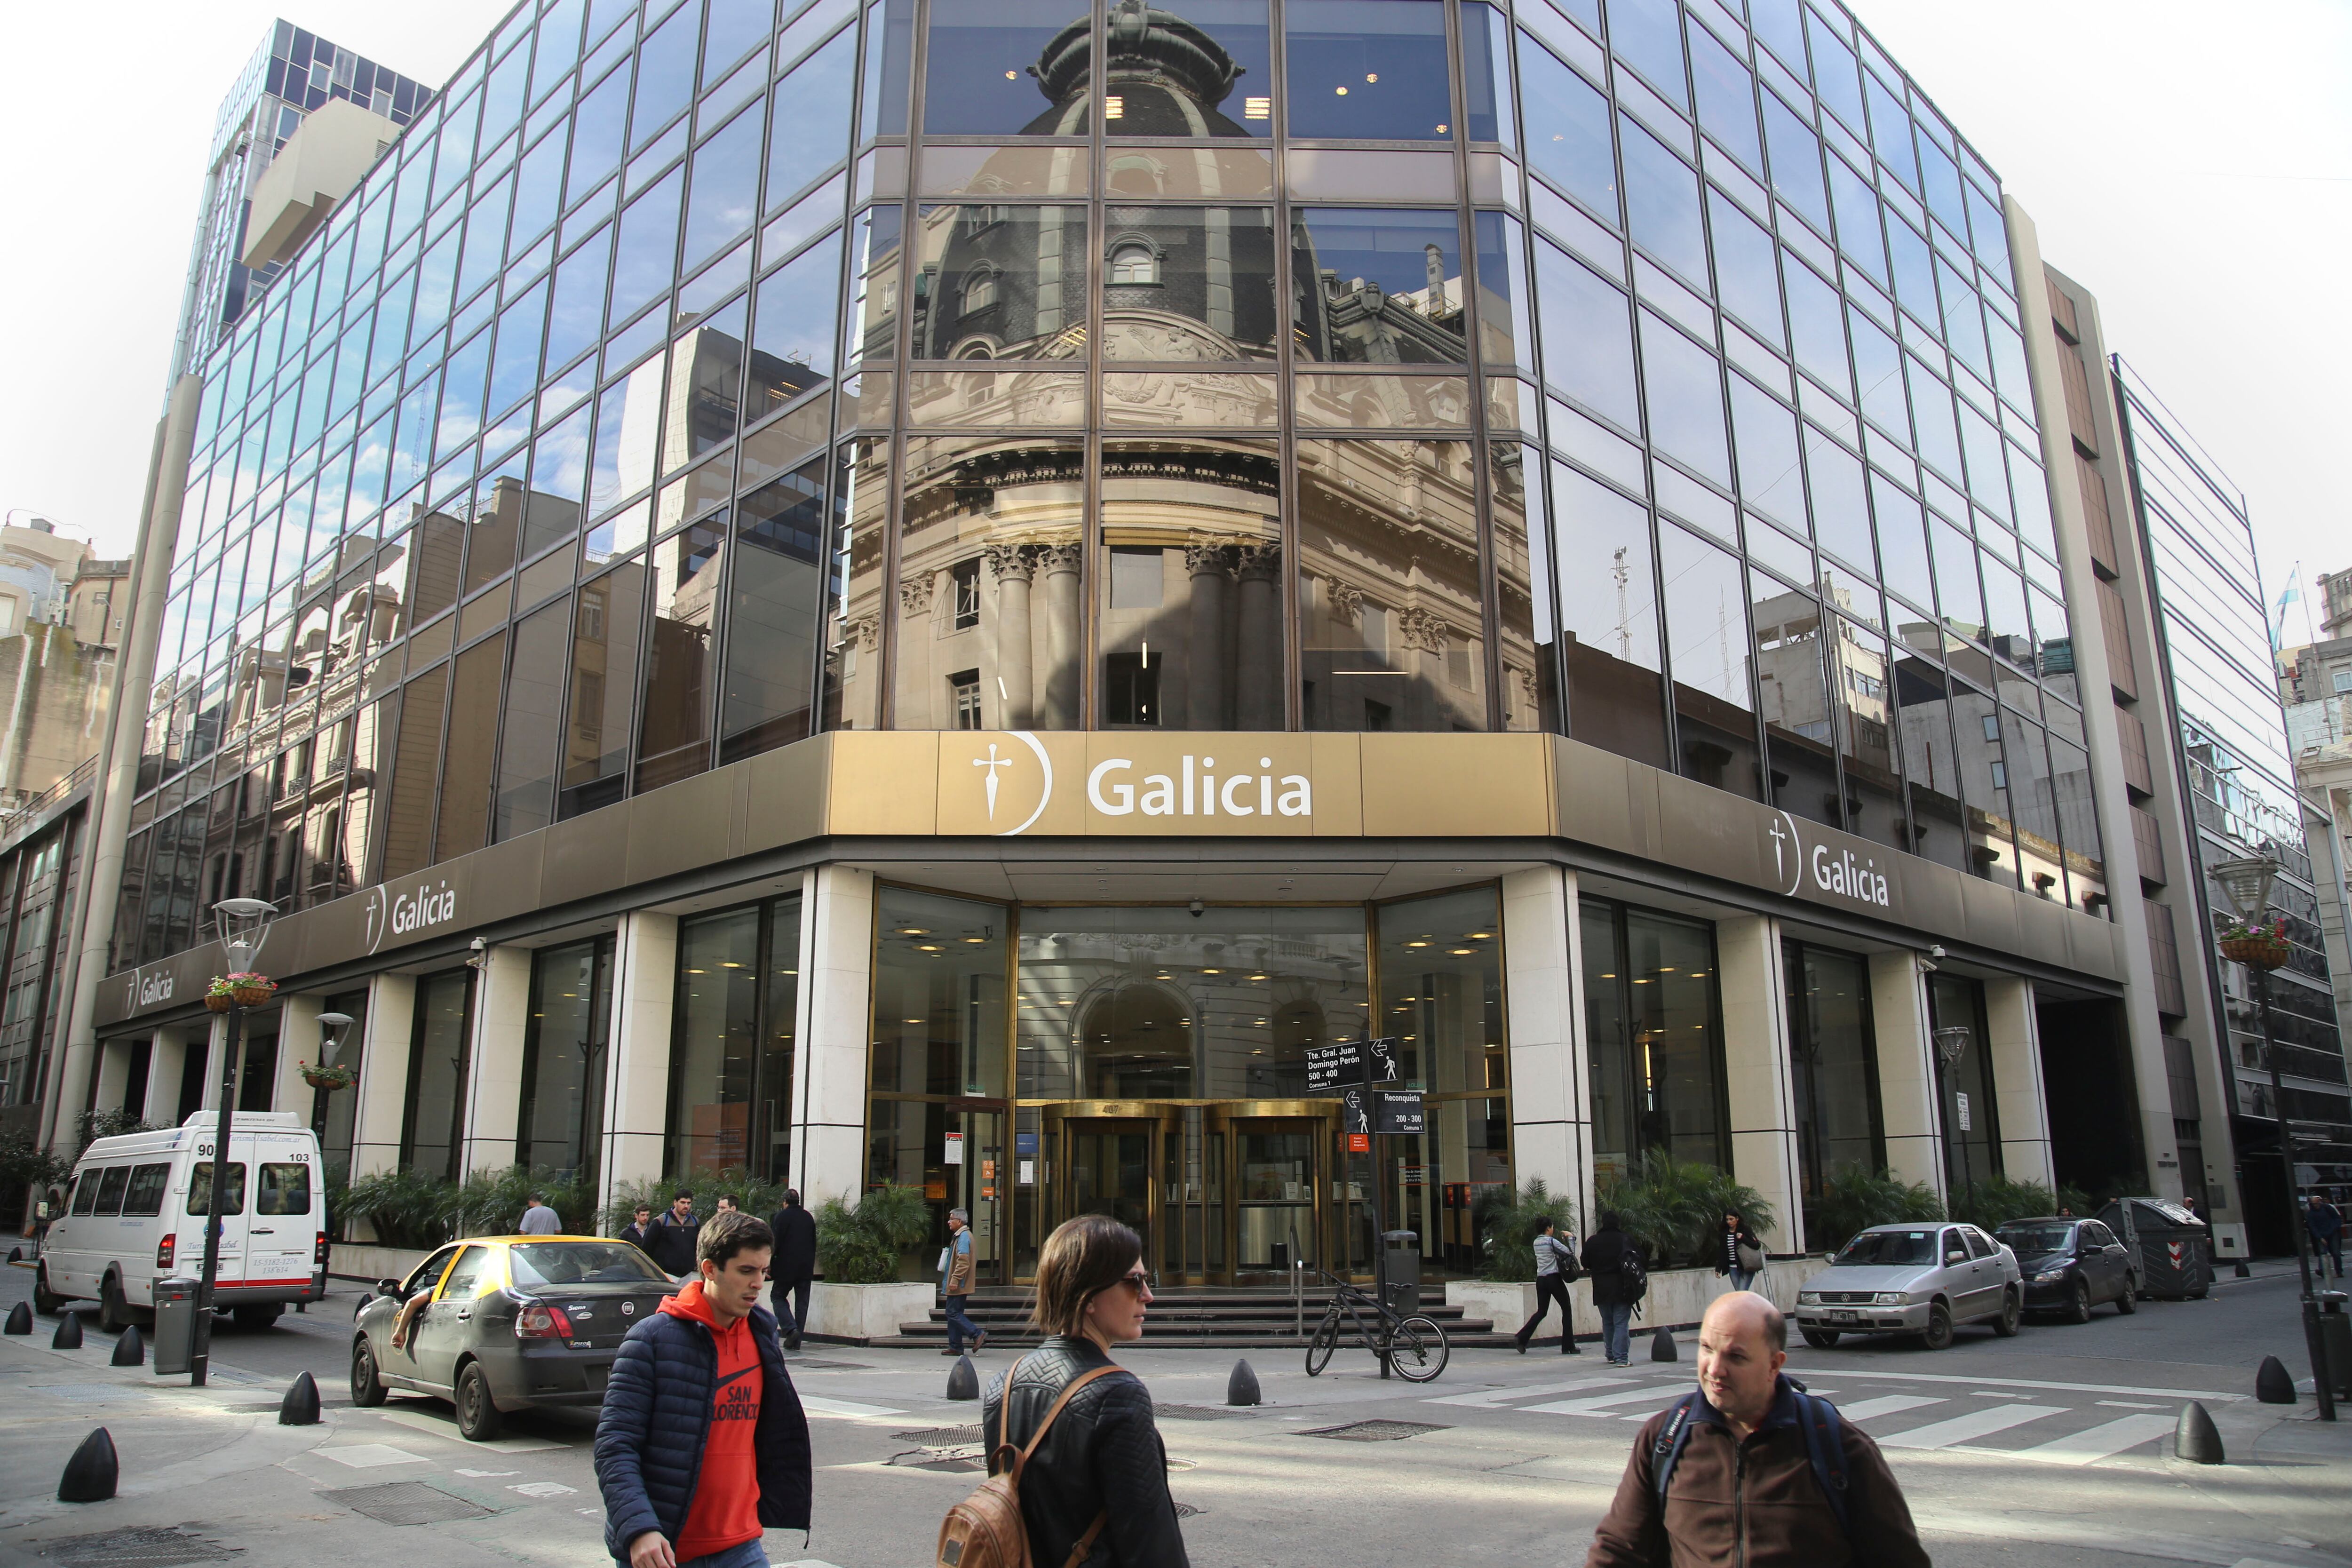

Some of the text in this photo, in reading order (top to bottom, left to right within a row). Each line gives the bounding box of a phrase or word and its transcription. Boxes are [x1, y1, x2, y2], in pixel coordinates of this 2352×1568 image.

[1087, 755, 1311, 817] Galicia
[1812, 844, 1889, 907] Galicia
[392, 880, 455, 934] Galicia
[140, 970, 173, 1006] Galicia
[1321, 1048, 1338, 1058] Gral.
[1339, 1047, 1356, 1055] Juan
[1308, 1055, 1360, 1070] Domingo Perón
[1326, 1069, 1338, 1078] 400
[1384, 1093, 1420, 1103] Reconquista
[199, 1144, 215, 1156] 90
[727, 1386, 752, 1403] SAN
[1667, 1413, 1683, 1436] UNIFORM
